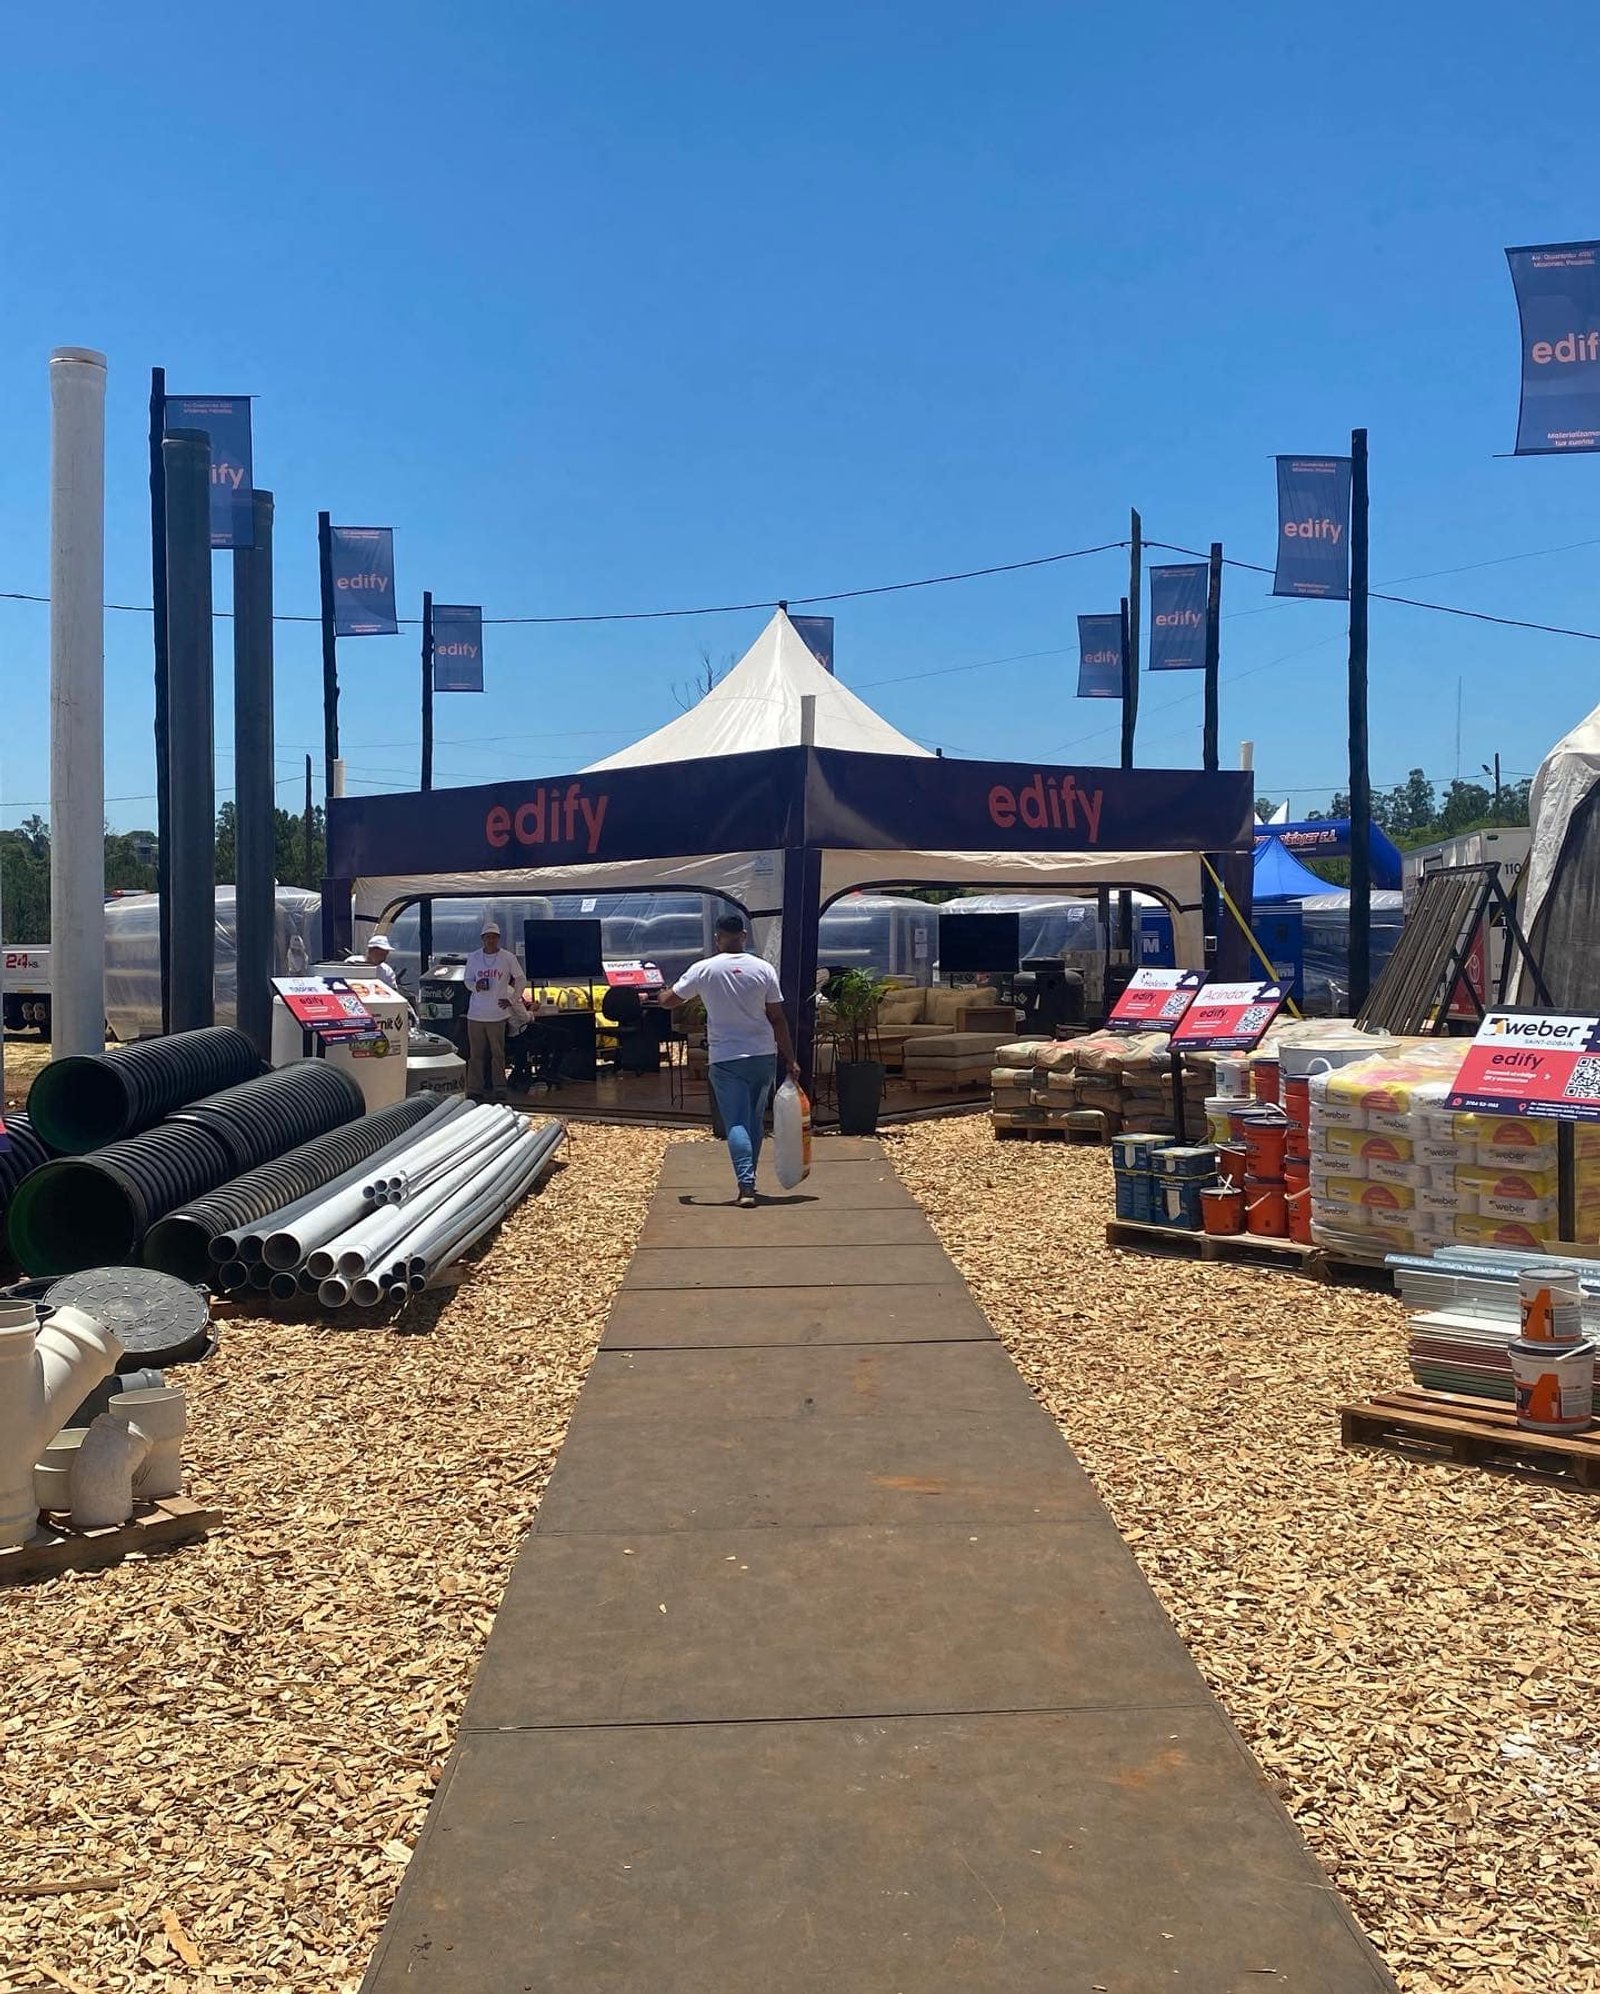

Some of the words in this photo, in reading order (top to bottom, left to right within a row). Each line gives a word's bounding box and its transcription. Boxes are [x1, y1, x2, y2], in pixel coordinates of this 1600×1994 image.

[1284, 518, 1342, 544] edify
[337, 573, 388, 592] edify
[1155, 610, 1202, 629] edify
[437, 643, 478, 658] edify
[1084, 650, 1119, 666] edify
[988, 773, 1103, 843] edify
[486, 783, 608, 854] edify
[6, 953, 28, 968] 24
[477, 968, 504, 979] edify
[1132, 992, 1157, 1002] edify
[1203, 988, 1248, 1000] Acindar
[299, 996, 324, 1007] edify
[1199, 1007, 1229, 1019] edify
[1505, 1020, 1580, 1038] weber
[1524, 1039, 1575, 1047] SAINT-GOBAIN
[1492, 1052, 1544, 1070] edify
[1324, 1110, 1351, 1120] weber
[1383, 1117, 1408, 1130] weber
[1430, 1147, 1458, 1157] weber
[1495, 1150, 1526, 1160] weber
[1324, 1159, 1349, 1169] weber
[1383, 1167, 1408, 1178] weber
[1430, 1196, 1458, 1206] weber
[1324, 1206, 1349, 1216] weber
[1495, 1202, 1526, 1214] weber
[1383, 1212, 1408, 1223] weber
